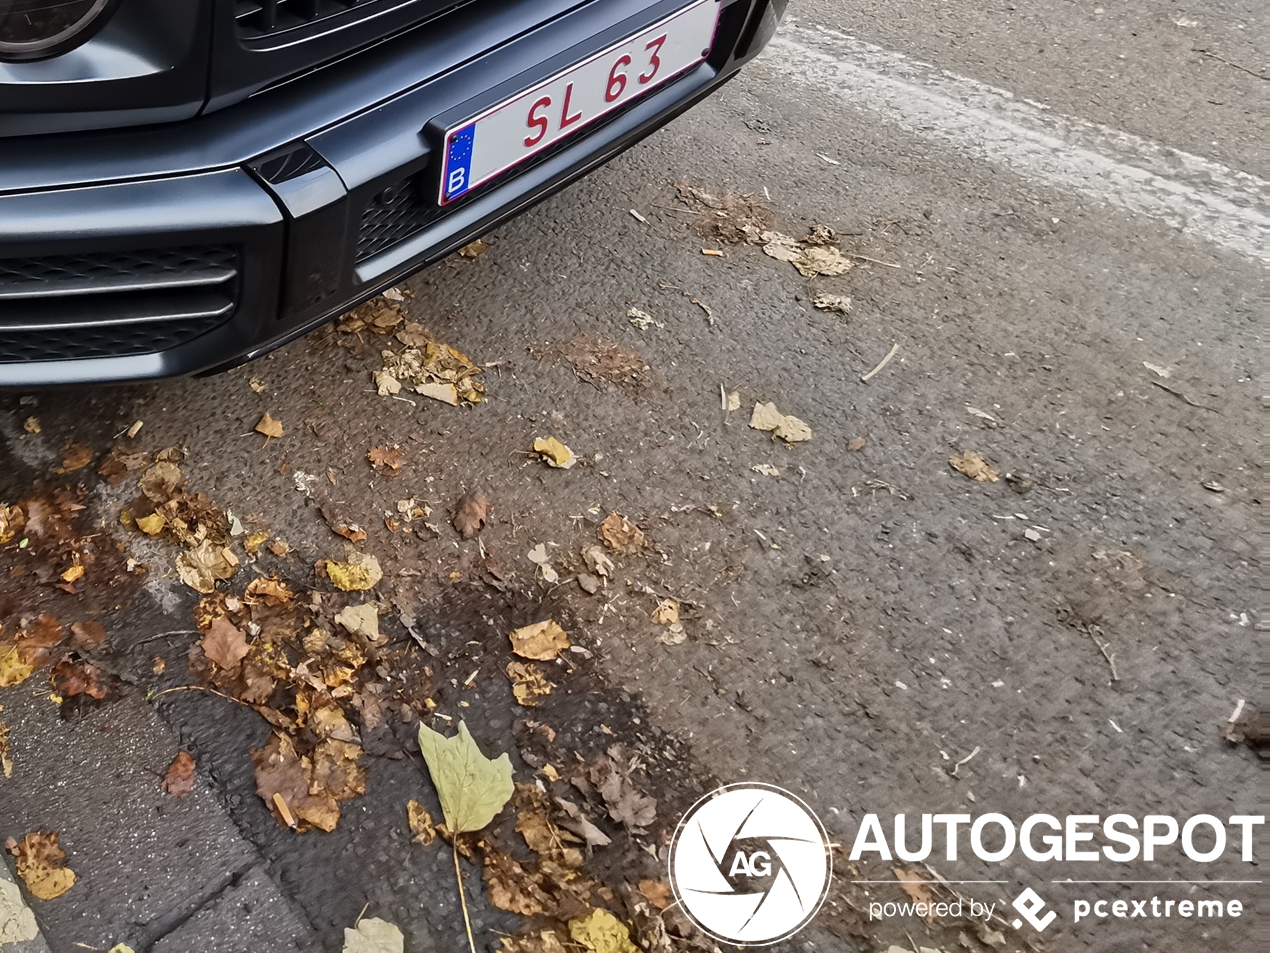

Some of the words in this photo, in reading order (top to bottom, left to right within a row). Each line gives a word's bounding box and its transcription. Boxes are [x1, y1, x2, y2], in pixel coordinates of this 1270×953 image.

[523, 82, 582, 148] SL
[604, 32, 668, 103] 63
[448, 166, 465, 194] B
